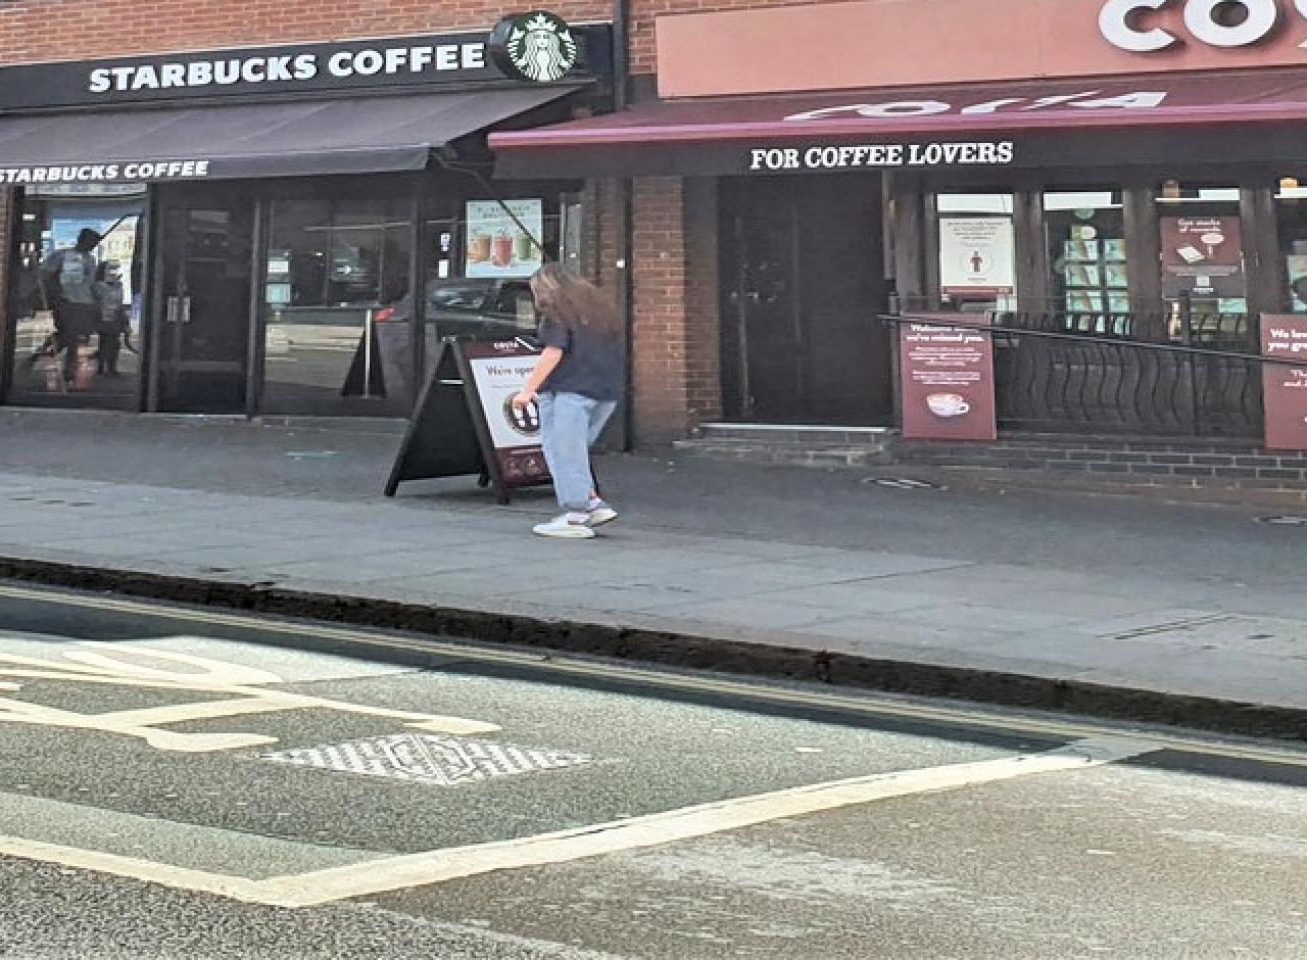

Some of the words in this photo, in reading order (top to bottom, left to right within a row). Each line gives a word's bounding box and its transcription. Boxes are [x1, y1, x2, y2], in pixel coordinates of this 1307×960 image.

[89, 54, 317, 93] STARBUCKS
[328, 42, 486, 77] COFFEE
[124, 160, 209, 178] COFFEE
[750, 148, 799, 170] FOR
[803, 144, 903, 168] COFFEE
[908, 141, 1014, 165] LOVERS
